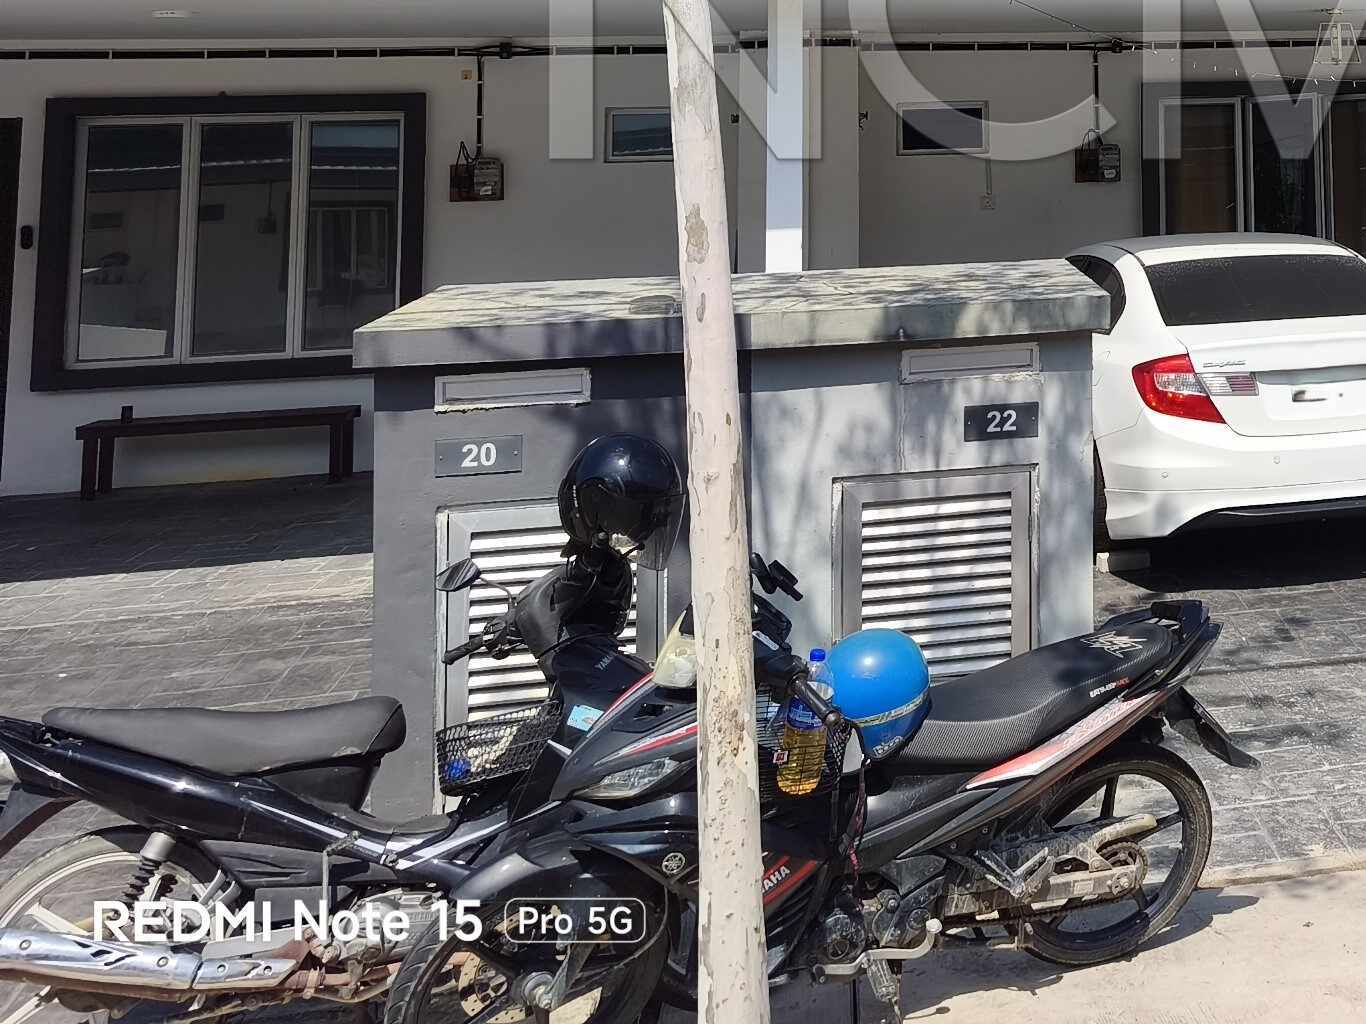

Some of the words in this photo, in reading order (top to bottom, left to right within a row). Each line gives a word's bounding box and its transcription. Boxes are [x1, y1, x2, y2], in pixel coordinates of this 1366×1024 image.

[986, 409, 1017, 432] 22
[461, 442, 497, 467] 20
[762, 865, 790, 893] AHA
